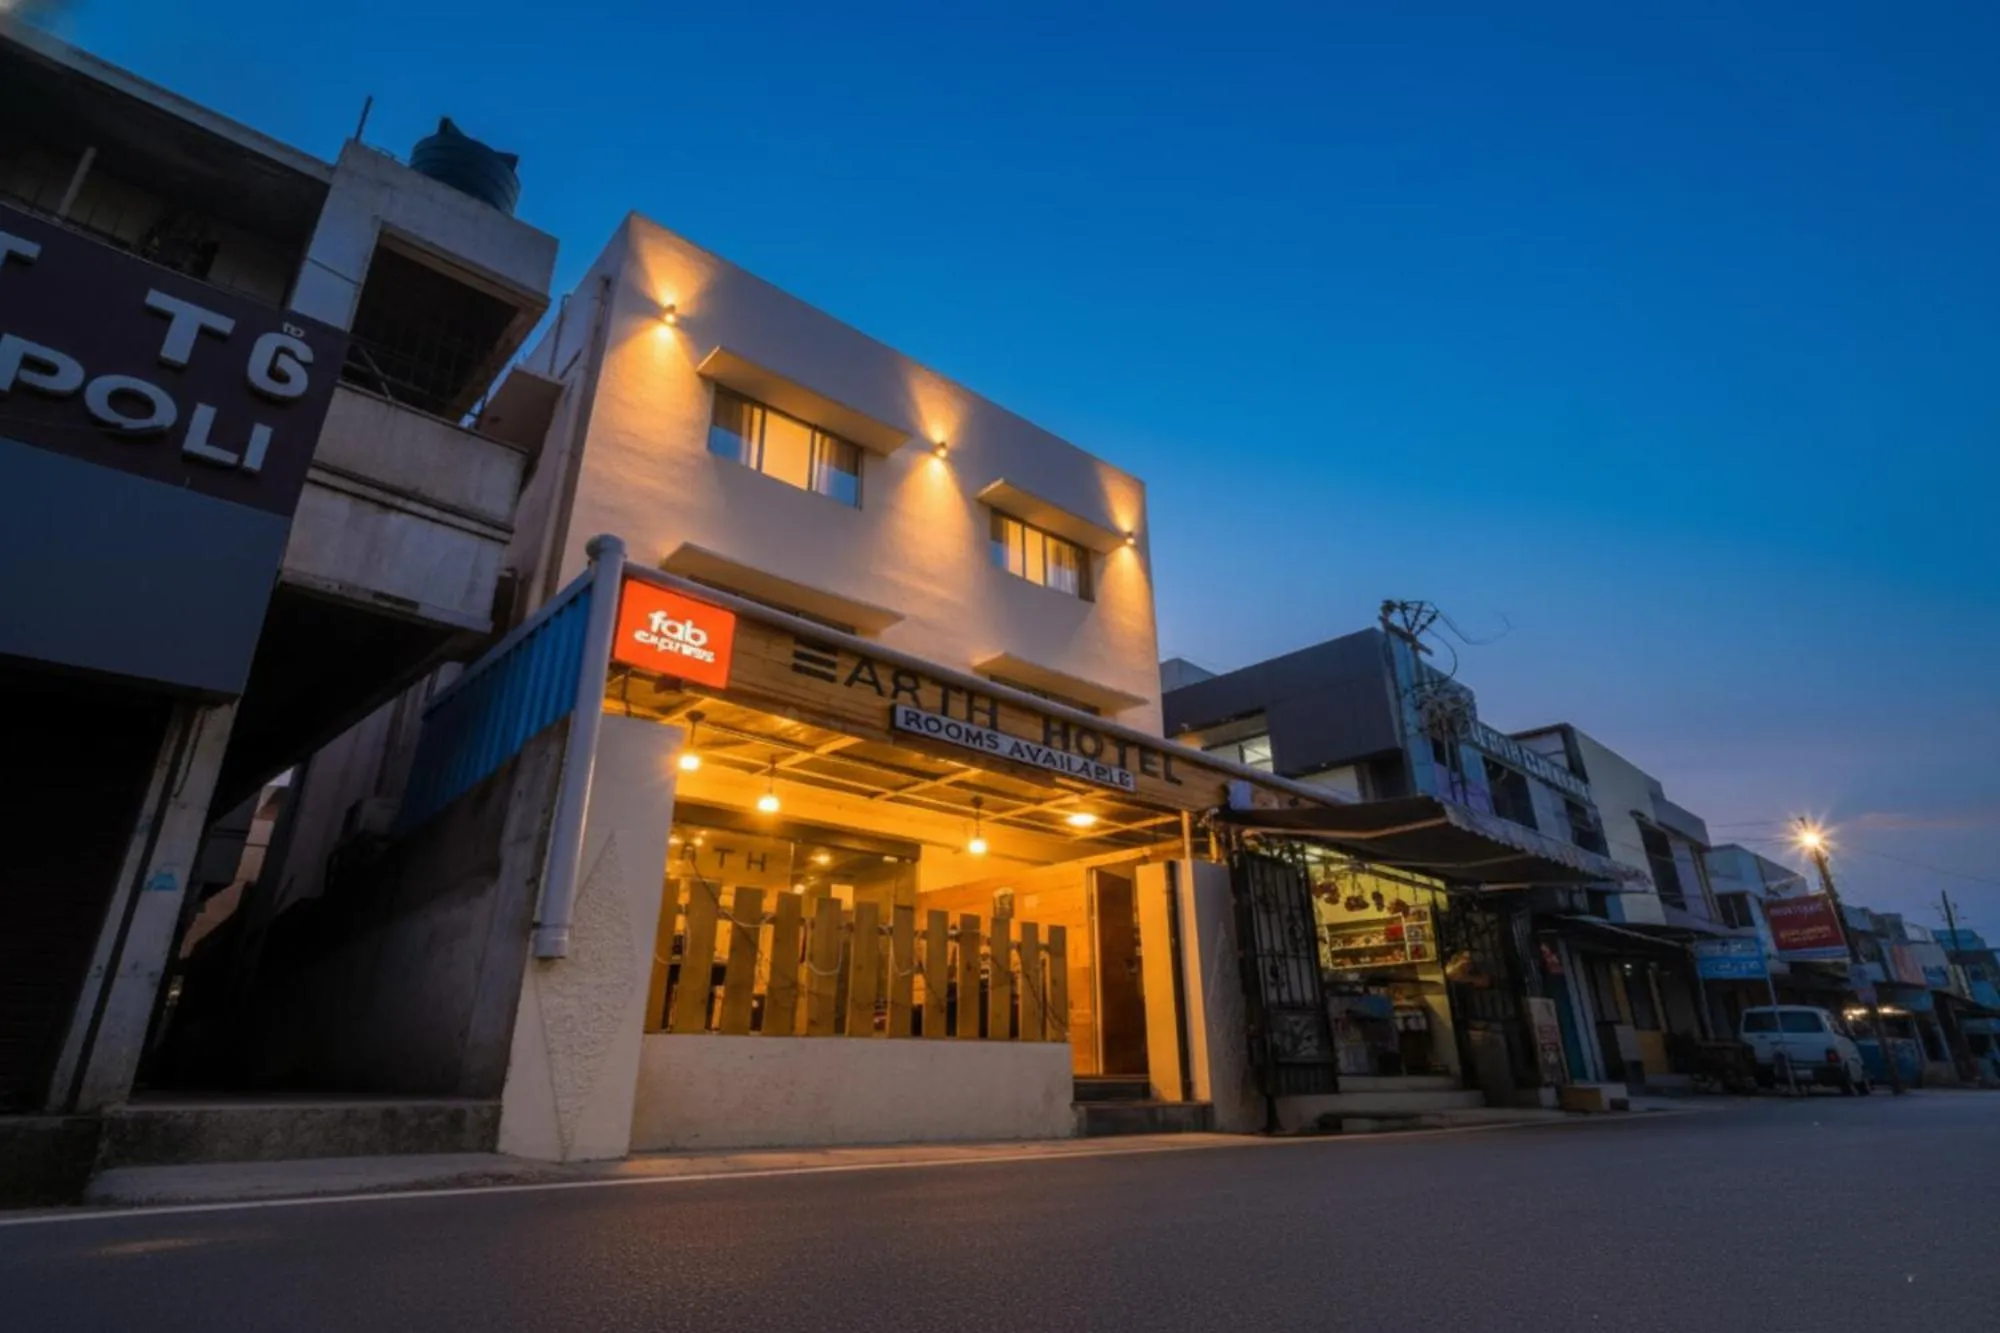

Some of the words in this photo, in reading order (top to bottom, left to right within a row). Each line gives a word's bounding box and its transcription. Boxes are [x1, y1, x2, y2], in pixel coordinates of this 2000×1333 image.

[634, 630, 717, 664] express
[648, 610, 708, 648] fab
[791, 636, 999, 731] EARTH
[1043, 715, 1183, 787] HOTEL
[903, 708, 1000, 751] ROOMS
[1008, 741, 1133, 788] AVAILABLE
